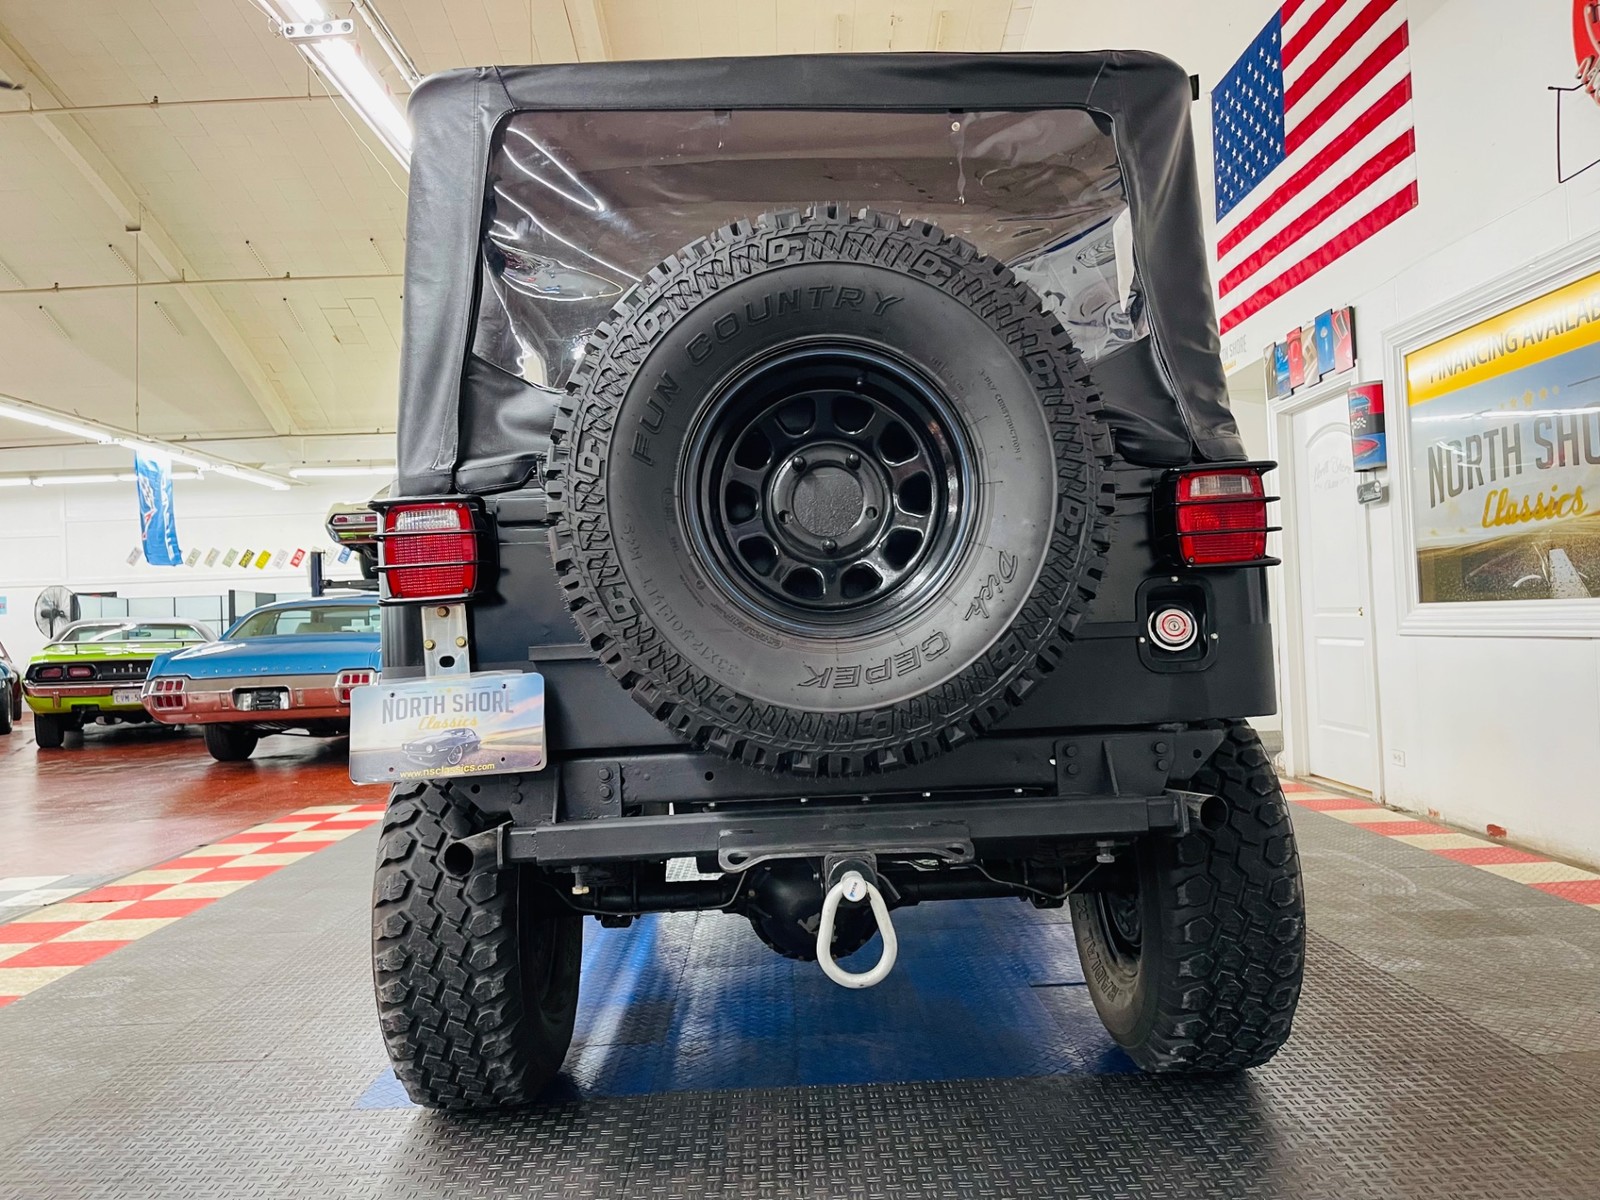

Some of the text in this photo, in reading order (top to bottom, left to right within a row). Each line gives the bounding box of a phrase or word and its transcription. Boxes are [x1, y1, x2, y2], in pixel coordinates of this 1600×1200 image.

[631, 284, 904, 466] FUN COUNTRY
[1430, 326, 1518, 383] FINANCING
[1428, 423, 1522, 508] NORTH
[1482, 485, 1588, 528] Classics
[797, 550, 1018, 689] Dick CEPEK
[382, 690, 514, 724] NORTH SHORE
[418, 716, 479, 731] Classics
[400, 762, 495, 779] www.nsclassics.com
